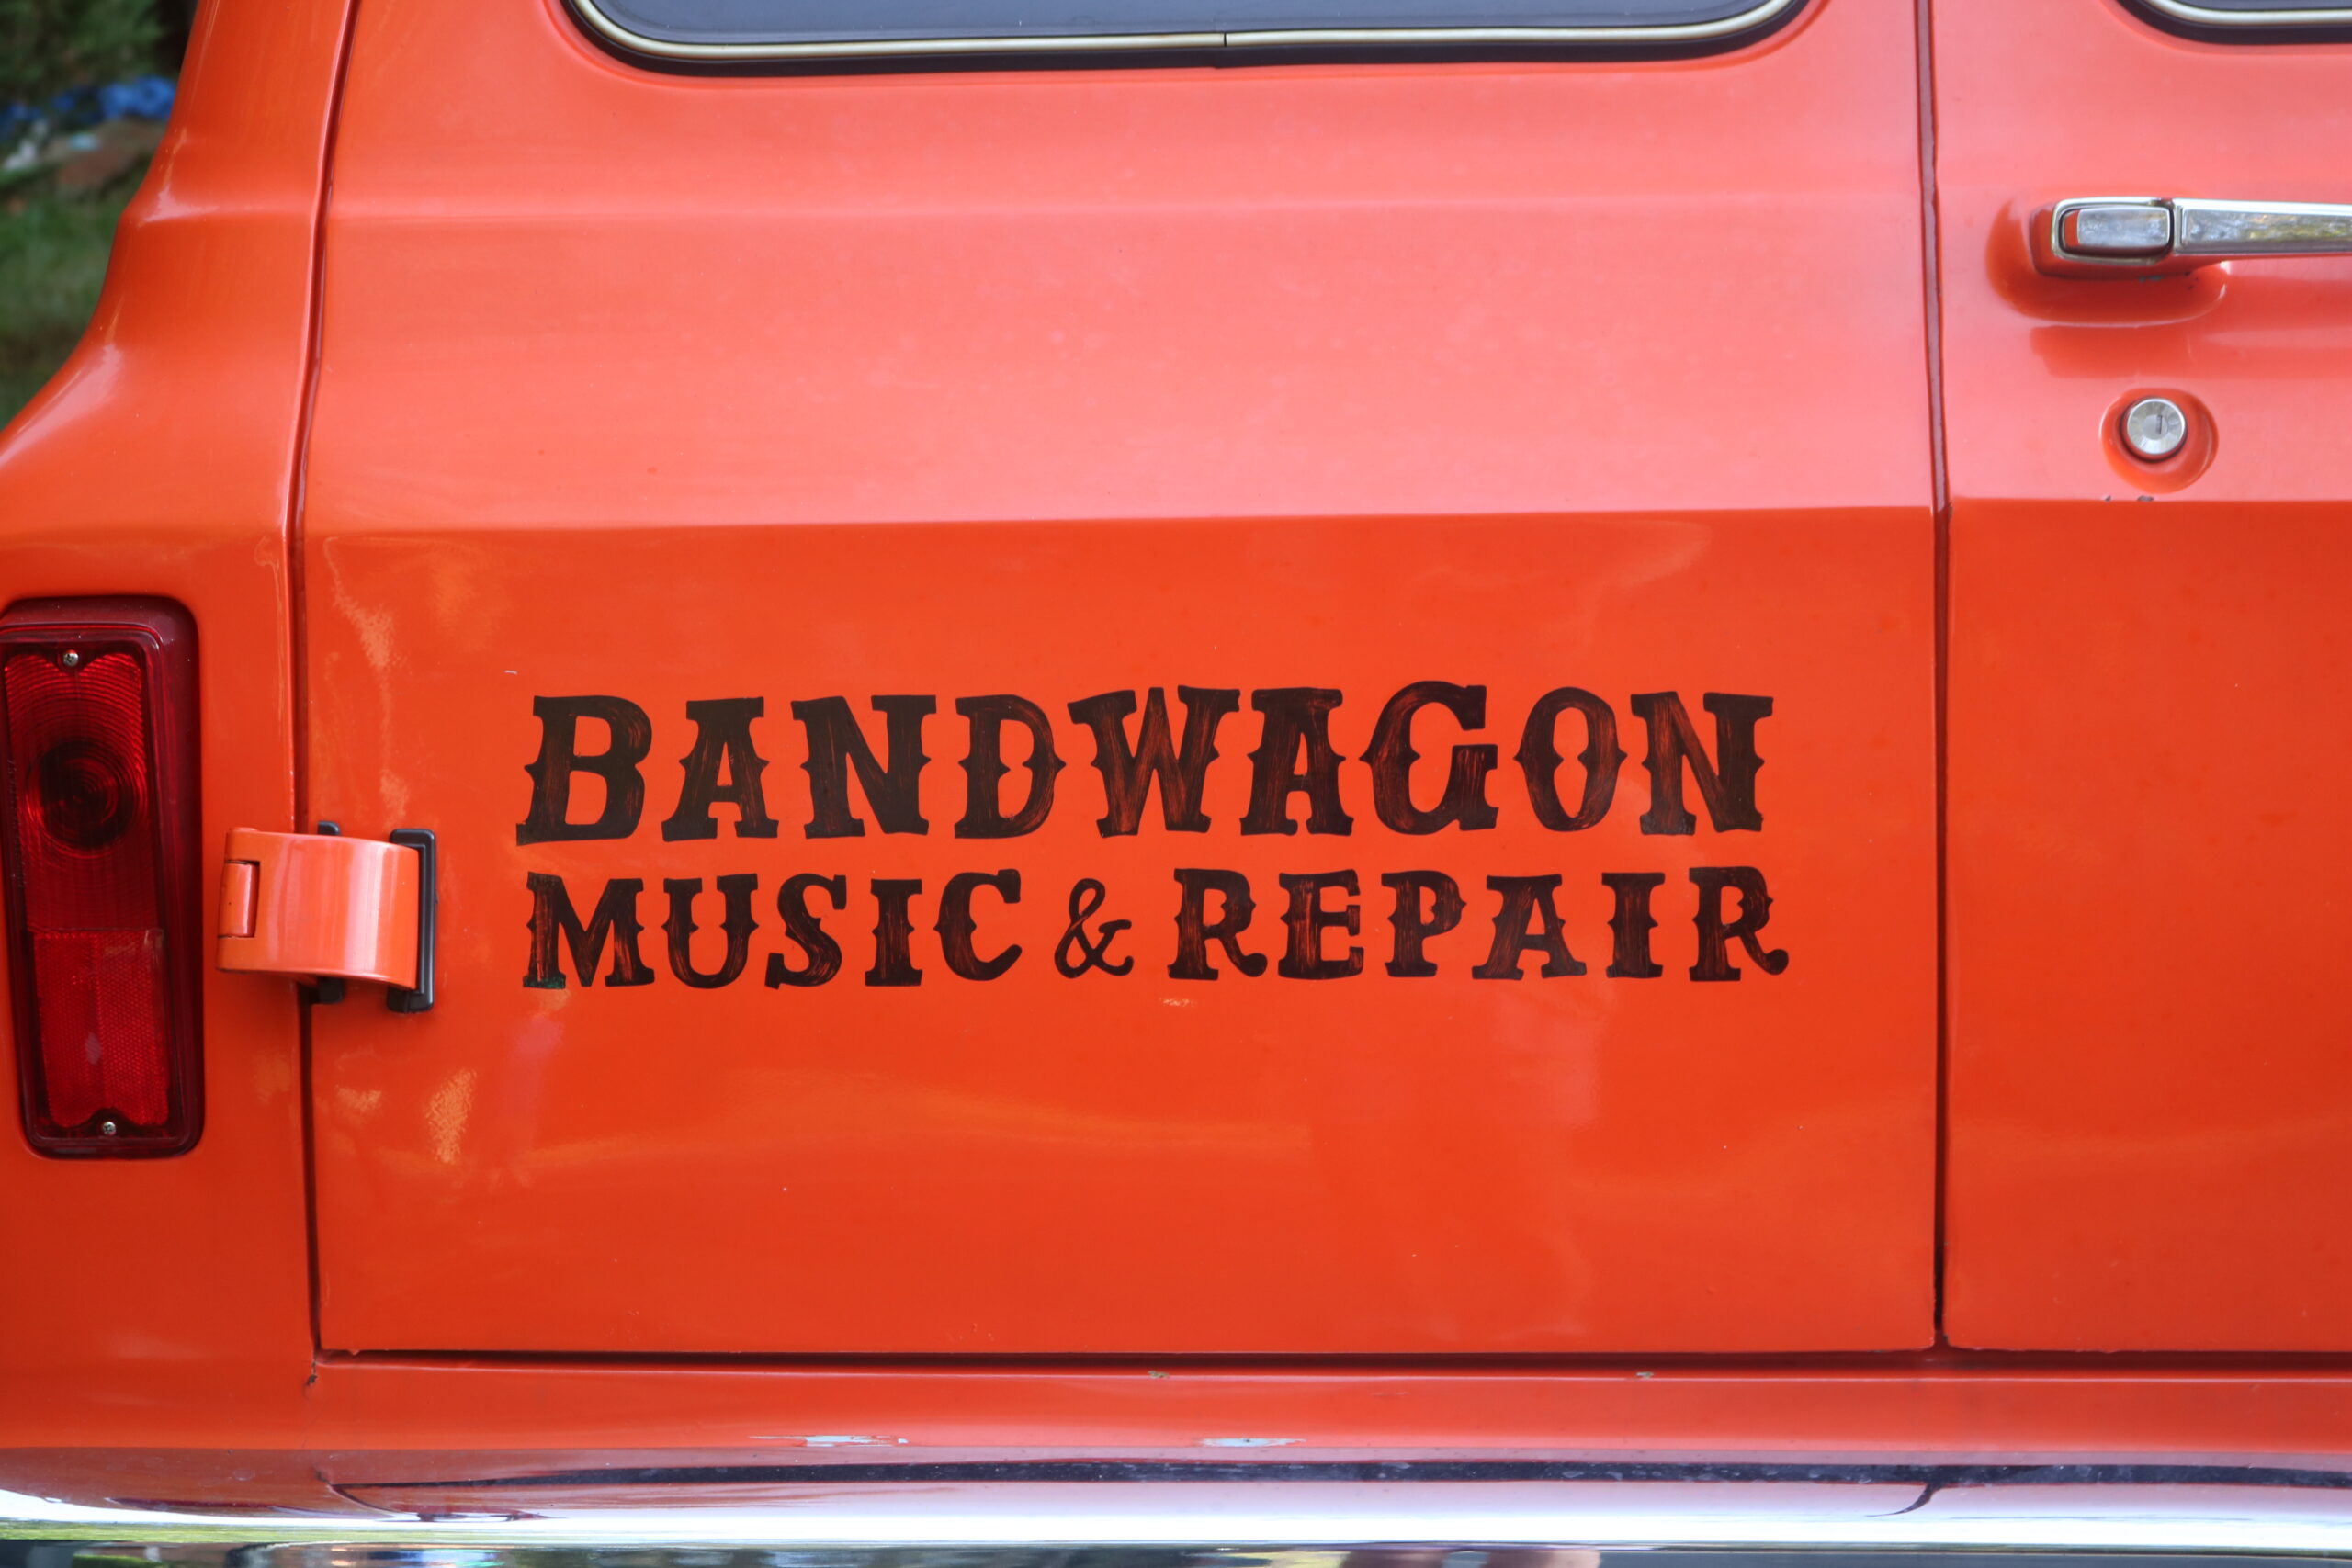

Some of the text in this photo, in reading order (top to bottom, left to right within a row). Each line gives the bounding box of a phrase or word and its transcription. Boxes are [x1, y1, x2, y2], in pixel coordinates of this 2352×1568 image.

[516, 682, 1774, 844] BANDWAGON
[523, 867, 1789, 989] MUSIC & REPAIR
